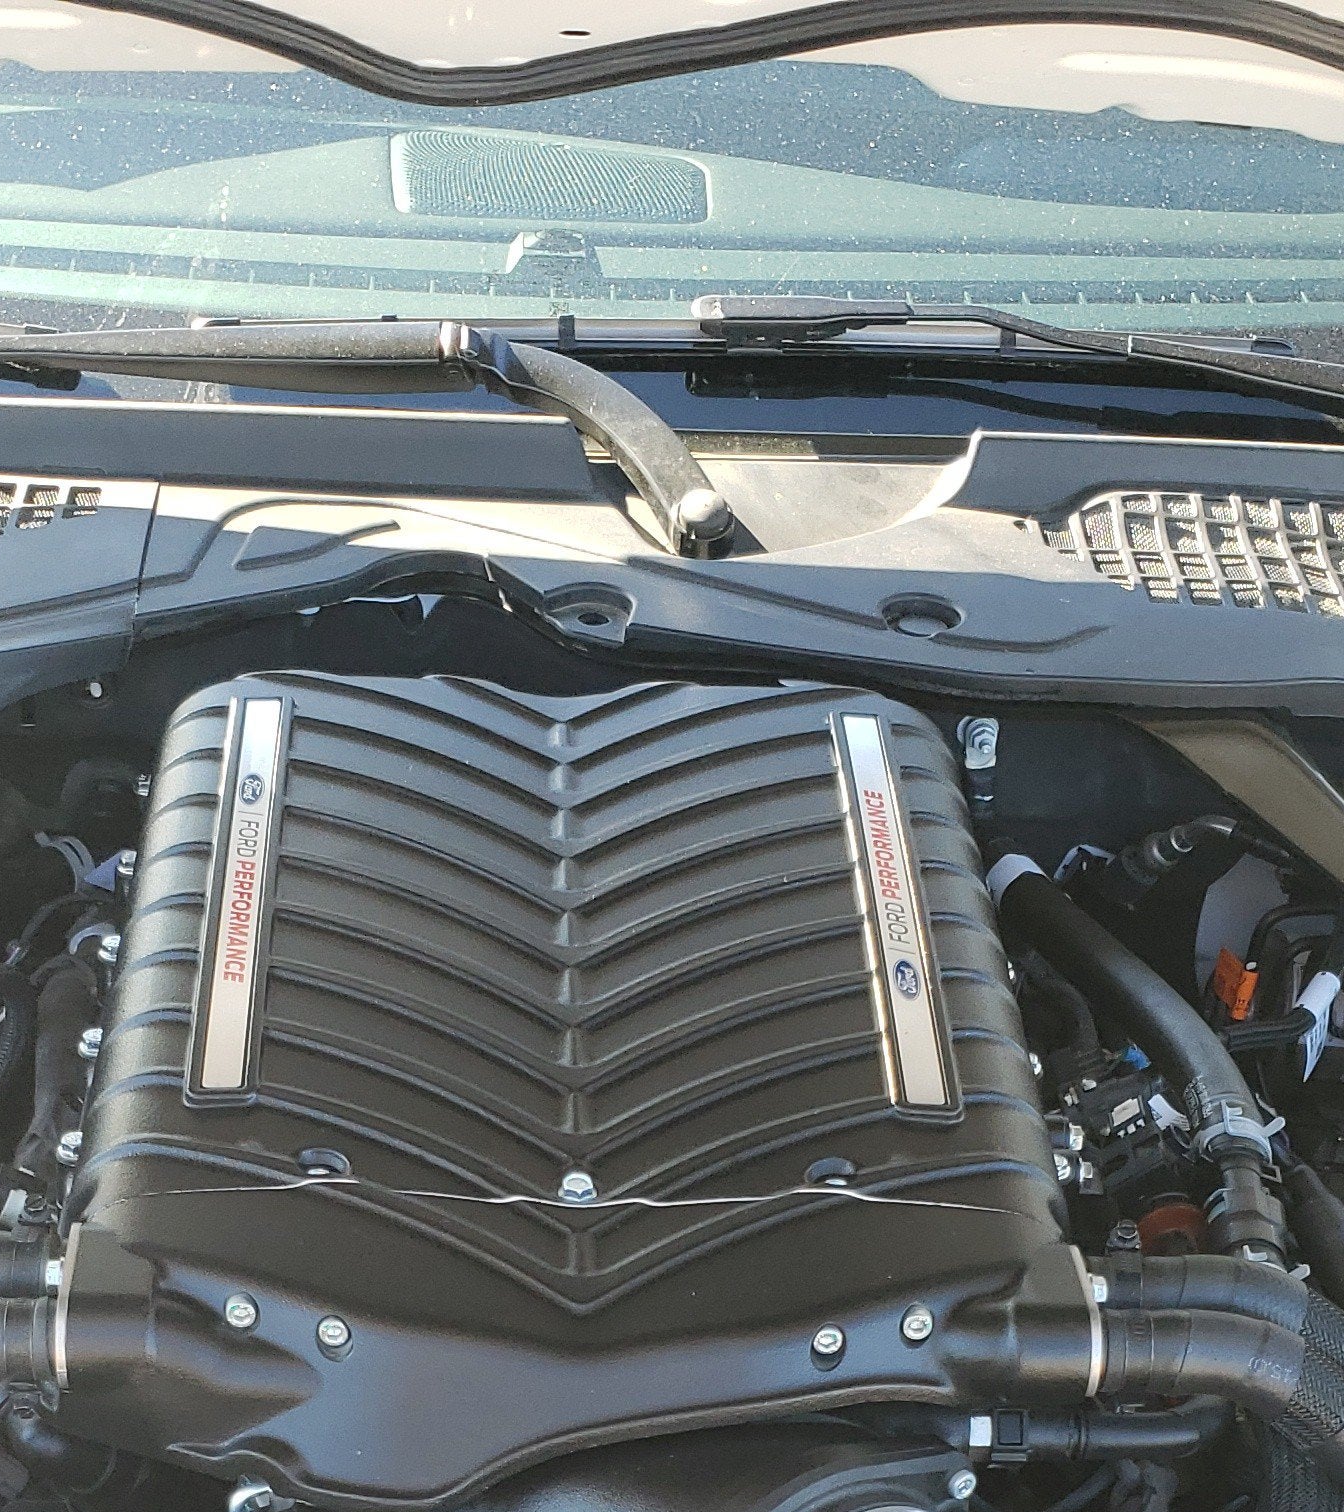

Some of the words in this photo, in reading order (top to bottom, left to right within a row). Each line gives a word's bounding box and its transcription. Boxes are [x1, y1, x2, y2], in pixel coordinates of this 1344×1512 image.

[242, 777, 263, 802] Ford
[238, 817, 260, 858] FORD
[864, 789, 903, 901] PERFORMANCE
[222, 859, 256, 984] PERFORMANCE
[888, 902, 911, 946] FORD
[894, 962, 920, 998] Ford
